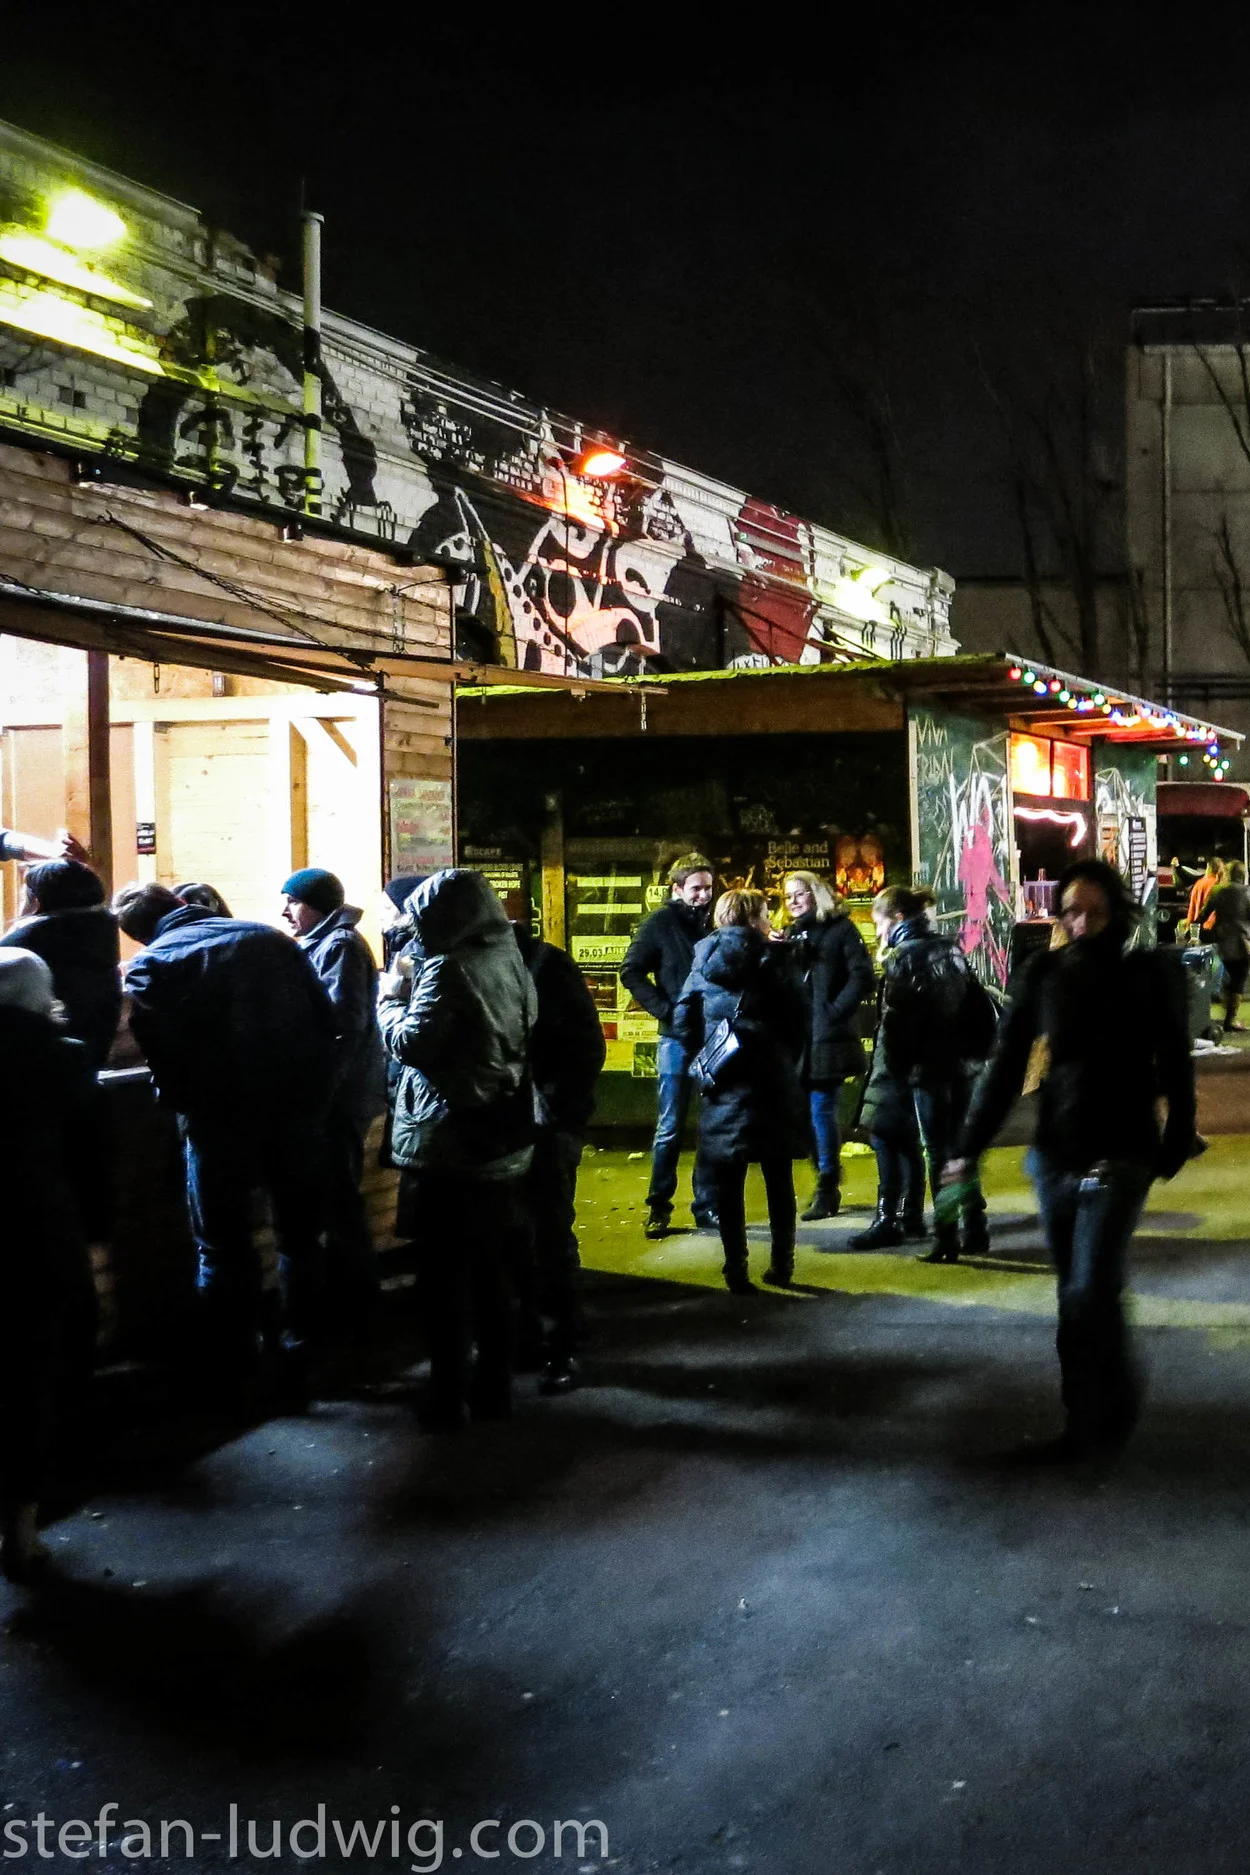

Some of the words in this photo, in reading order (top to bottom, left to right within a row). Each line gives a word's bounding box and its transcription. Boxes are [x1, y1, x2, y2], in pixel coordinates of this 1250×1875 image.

[768, 841, 800, 854] Belle
[803, 840, 828, 854] and
[767, 856, 830, 868] Sebastian
